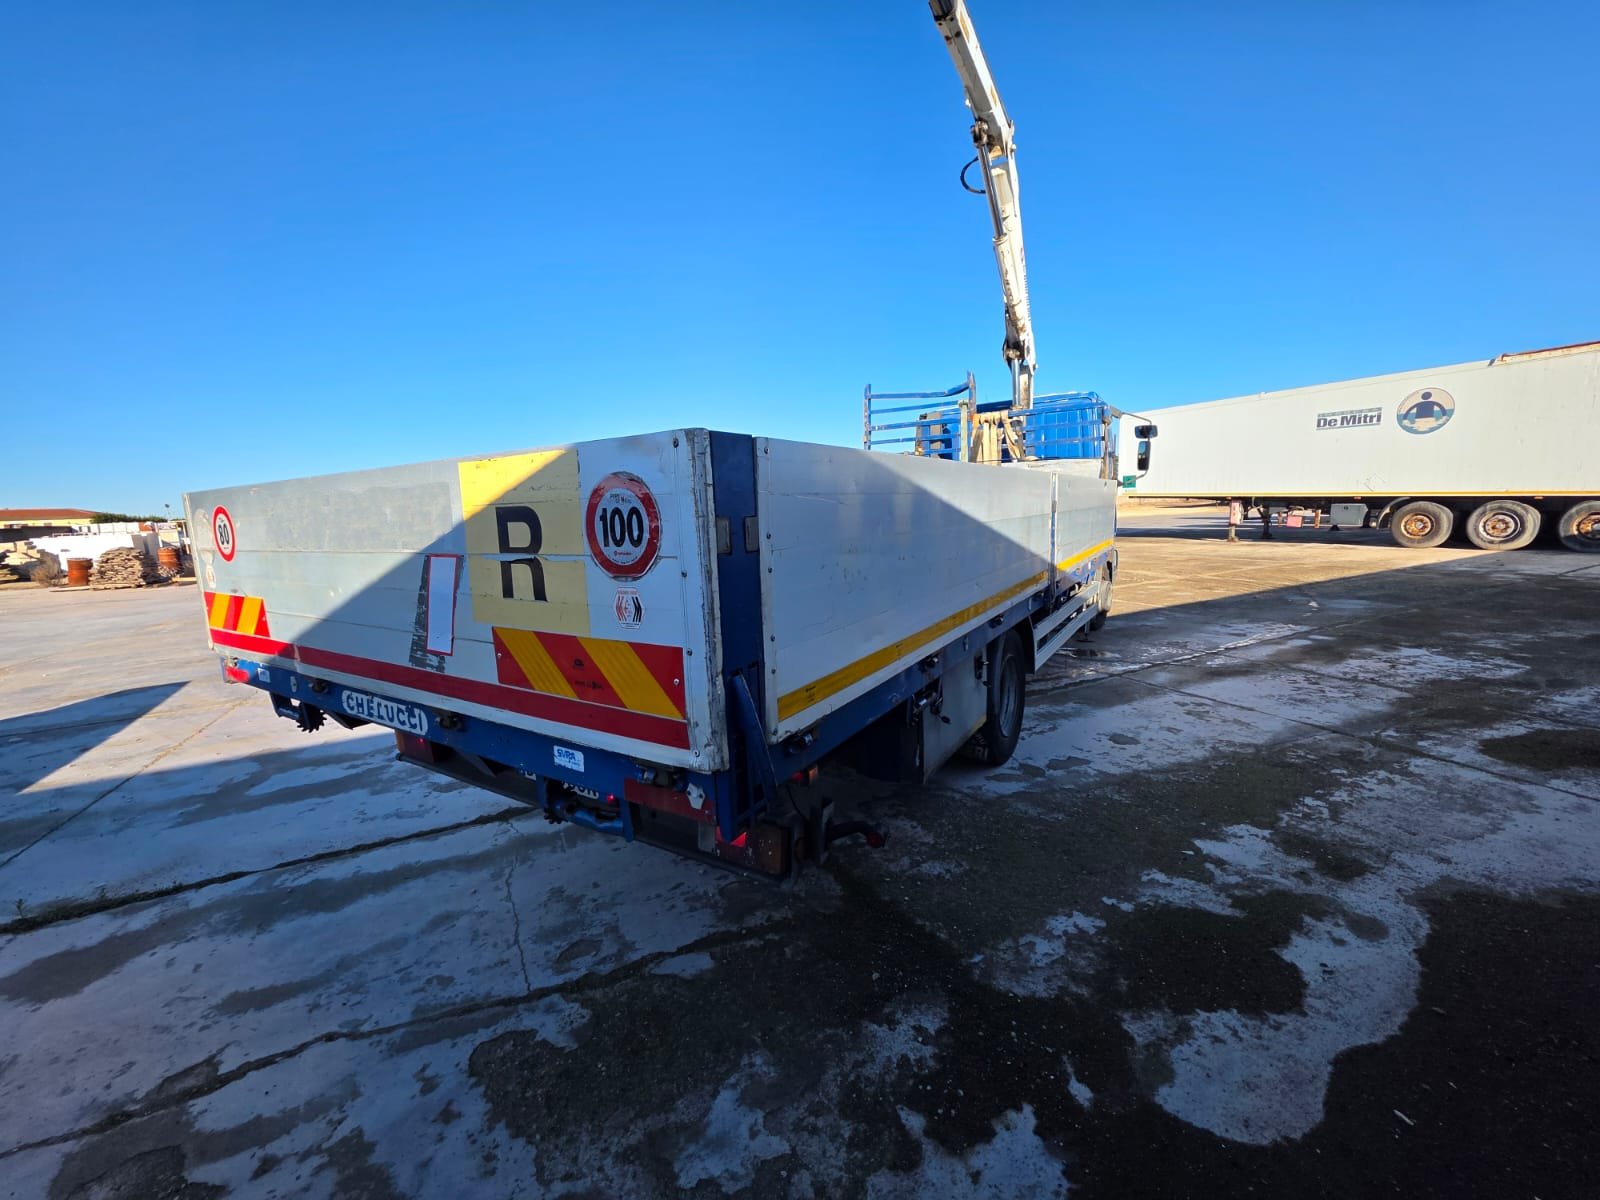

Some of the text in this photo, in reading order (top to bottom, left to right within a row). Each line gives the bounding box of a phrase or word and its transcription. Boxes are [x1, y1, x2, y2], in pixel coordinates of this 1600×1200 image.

[1316, 417, 1338, 428] De
[1340, 412, 1382, 426] Mitri
[218, 523, 229, 545] 80
[600, 506, 644, 548] 100
[495, 505, 548, 602] R
[346, 692, 423, 732] CHELUCCI
